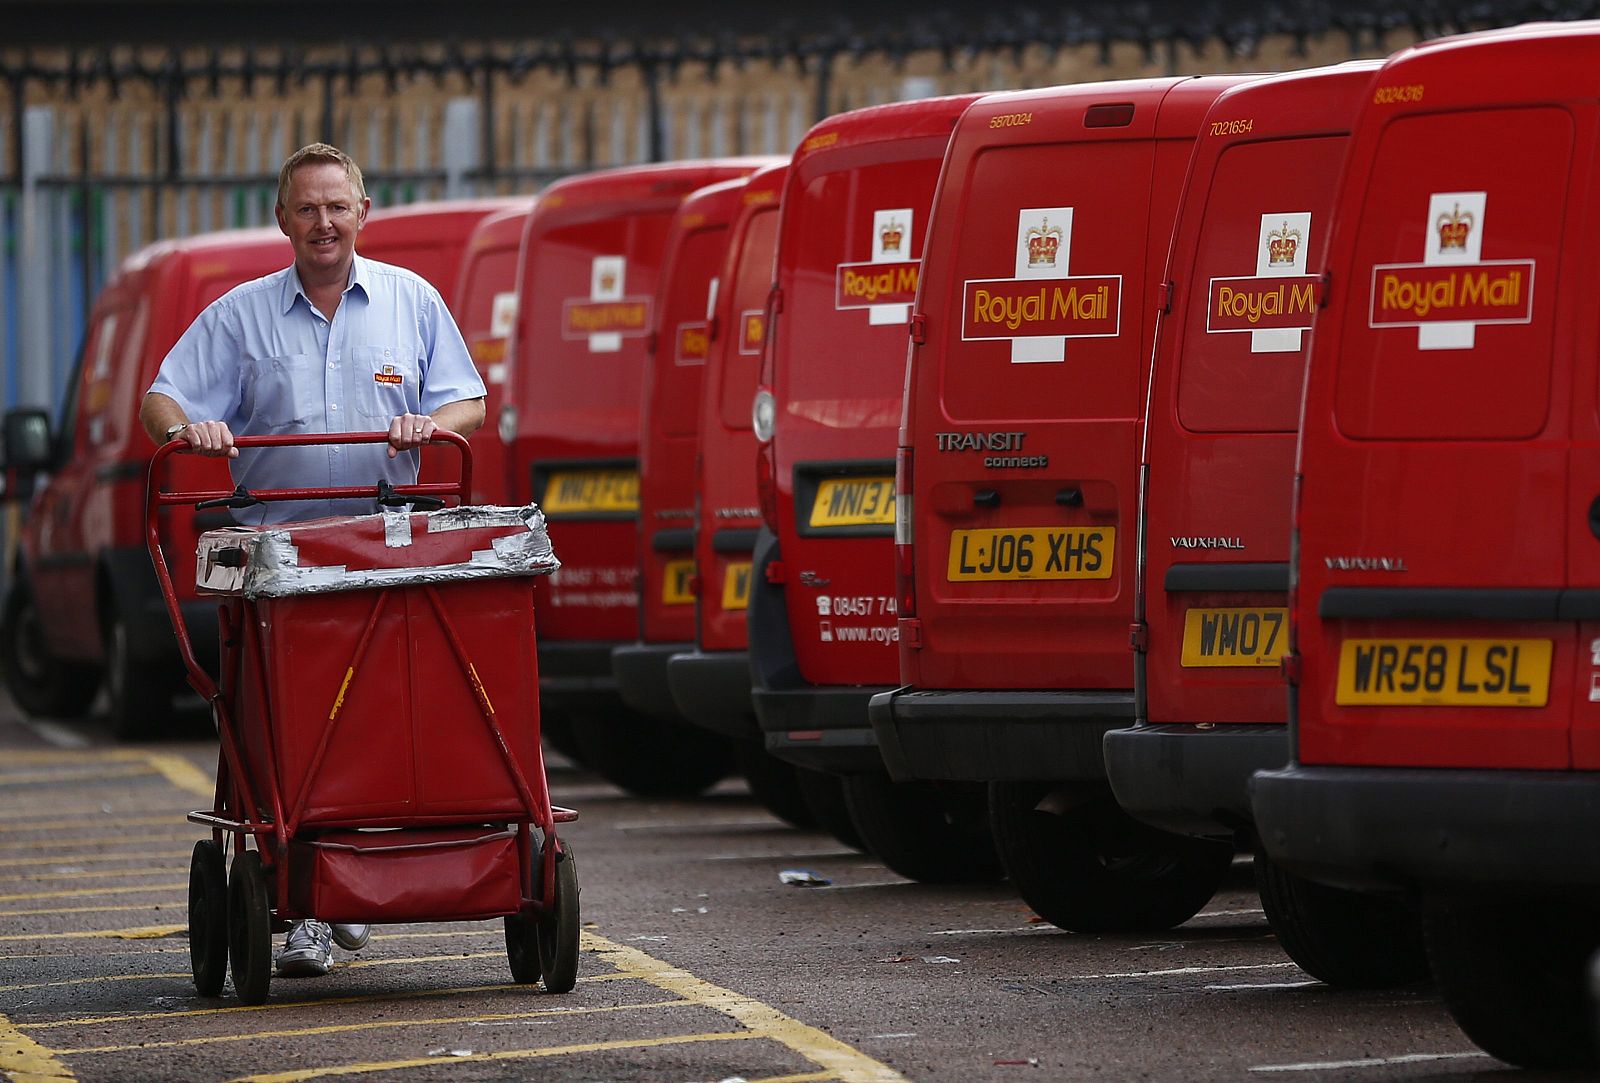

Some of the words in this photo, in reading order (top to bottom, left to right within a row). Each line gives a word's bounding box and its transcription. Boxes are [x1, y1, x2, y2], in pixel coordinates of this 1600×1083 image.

[990, 113, 1032, 128] 5870024
[1210, 119, 1253, 136] 7021654
[844, 269, 895, 300] Royal
[1382, 271, 1456, 316] Royal
[1461, 271, 1521, 307] Mail
[974, 287, 1046, 329] Royal
[1050, 286, 1109, 320] Mail
[1218, 284, 1285, 322] Royal
[935, 432, 1027, 451] TRANSIT
[983, 455, 1048, 469] connect
[827, 482, 882, 517] WN13
[959, 534, 1035, 573] LJ06
[1045, 533, 1104, 572] XHS
[1170, 536, 1245, 549] VAUXHALL
[1324, 557, 1408, 571] VAUXHALL
[833, 597, 874, 615] 08457
[877, 597, 897, 615] 74
[1200, 613, 1283, 656] WM07
[1354, 645, 1447, 693] WR58
[1456, 644, 1531, 693] LSL
